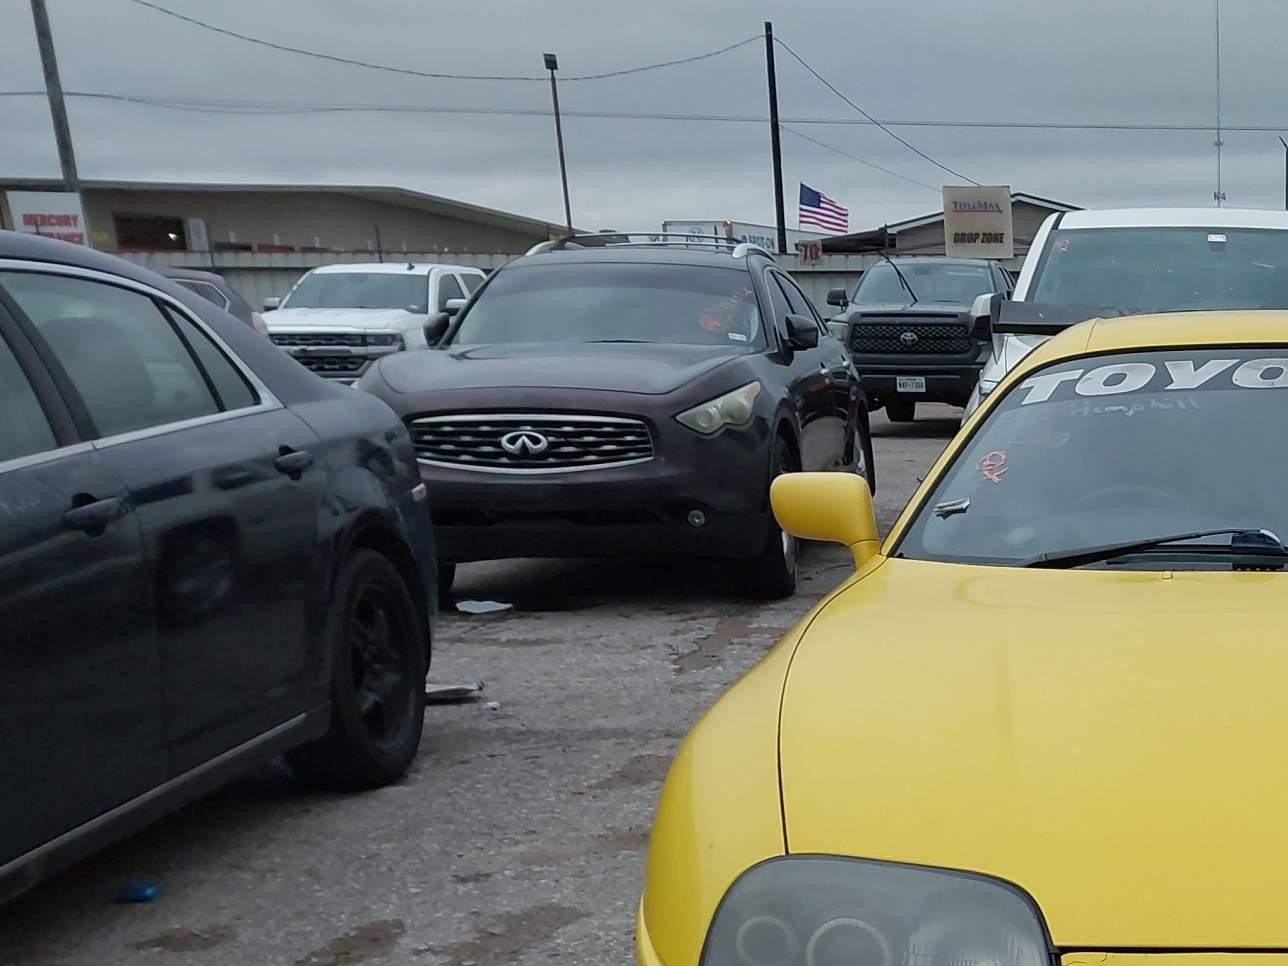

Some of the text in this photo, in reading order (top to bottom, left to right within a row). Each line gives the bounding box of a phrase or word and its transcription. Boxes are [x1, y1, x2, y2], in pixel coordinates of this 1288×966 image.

[22, 212, 79, 227] MERCURY
[953, 232, 1005, 244] DROP ZONE
